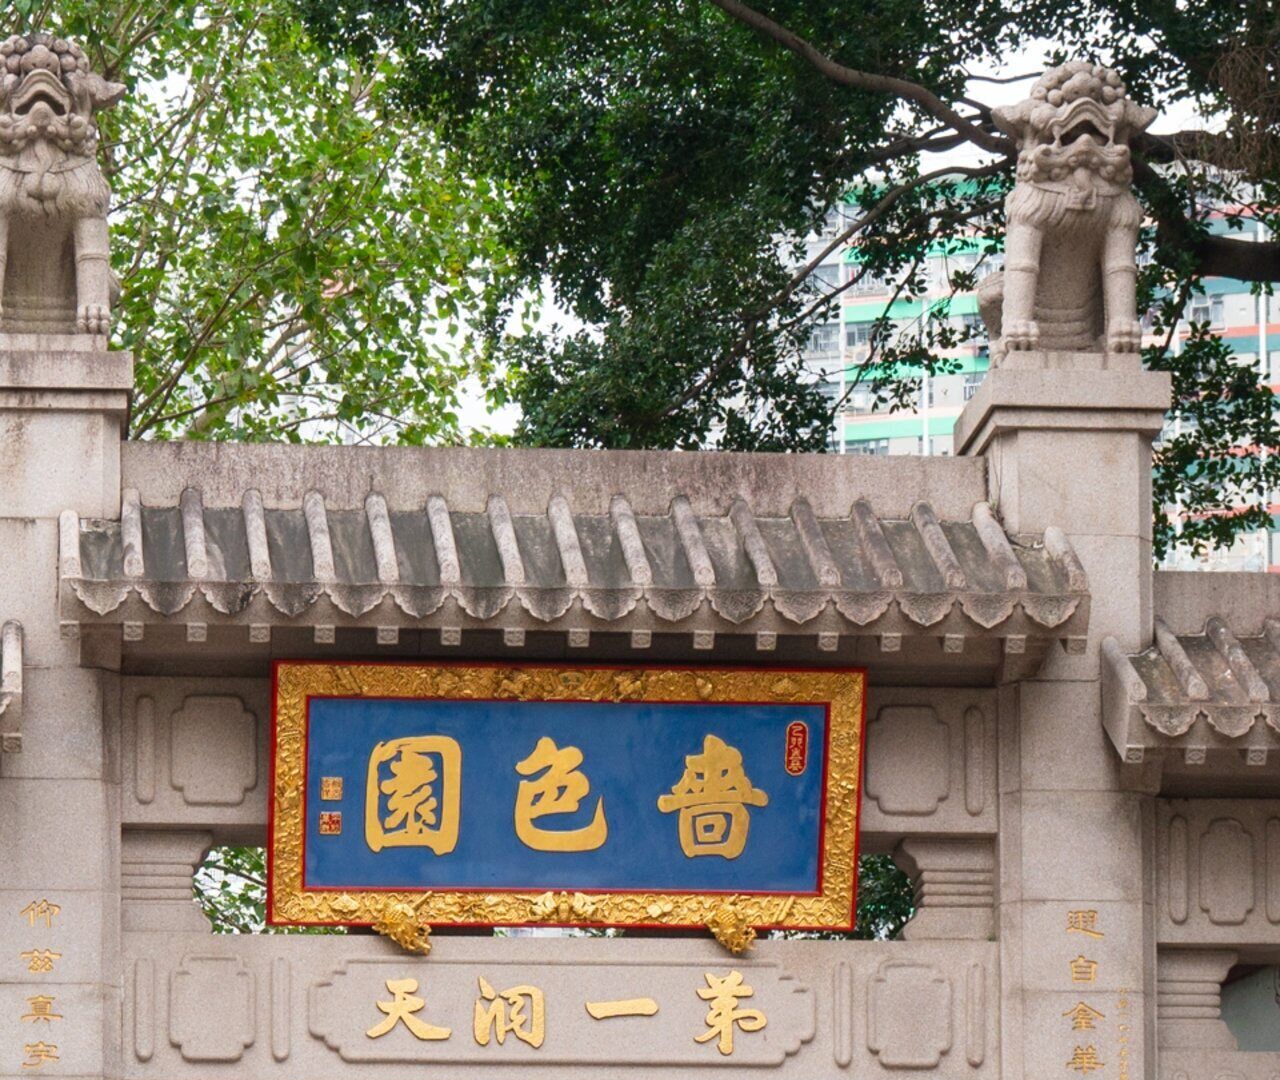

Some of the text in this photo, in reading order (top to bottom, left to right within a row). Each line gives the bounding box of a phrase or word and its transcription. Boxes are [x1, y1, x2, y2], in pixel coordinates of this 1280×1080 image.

[363, 734, 768, 859] 嗇色園
[366, 970, 767, 1055] 第一洞天
